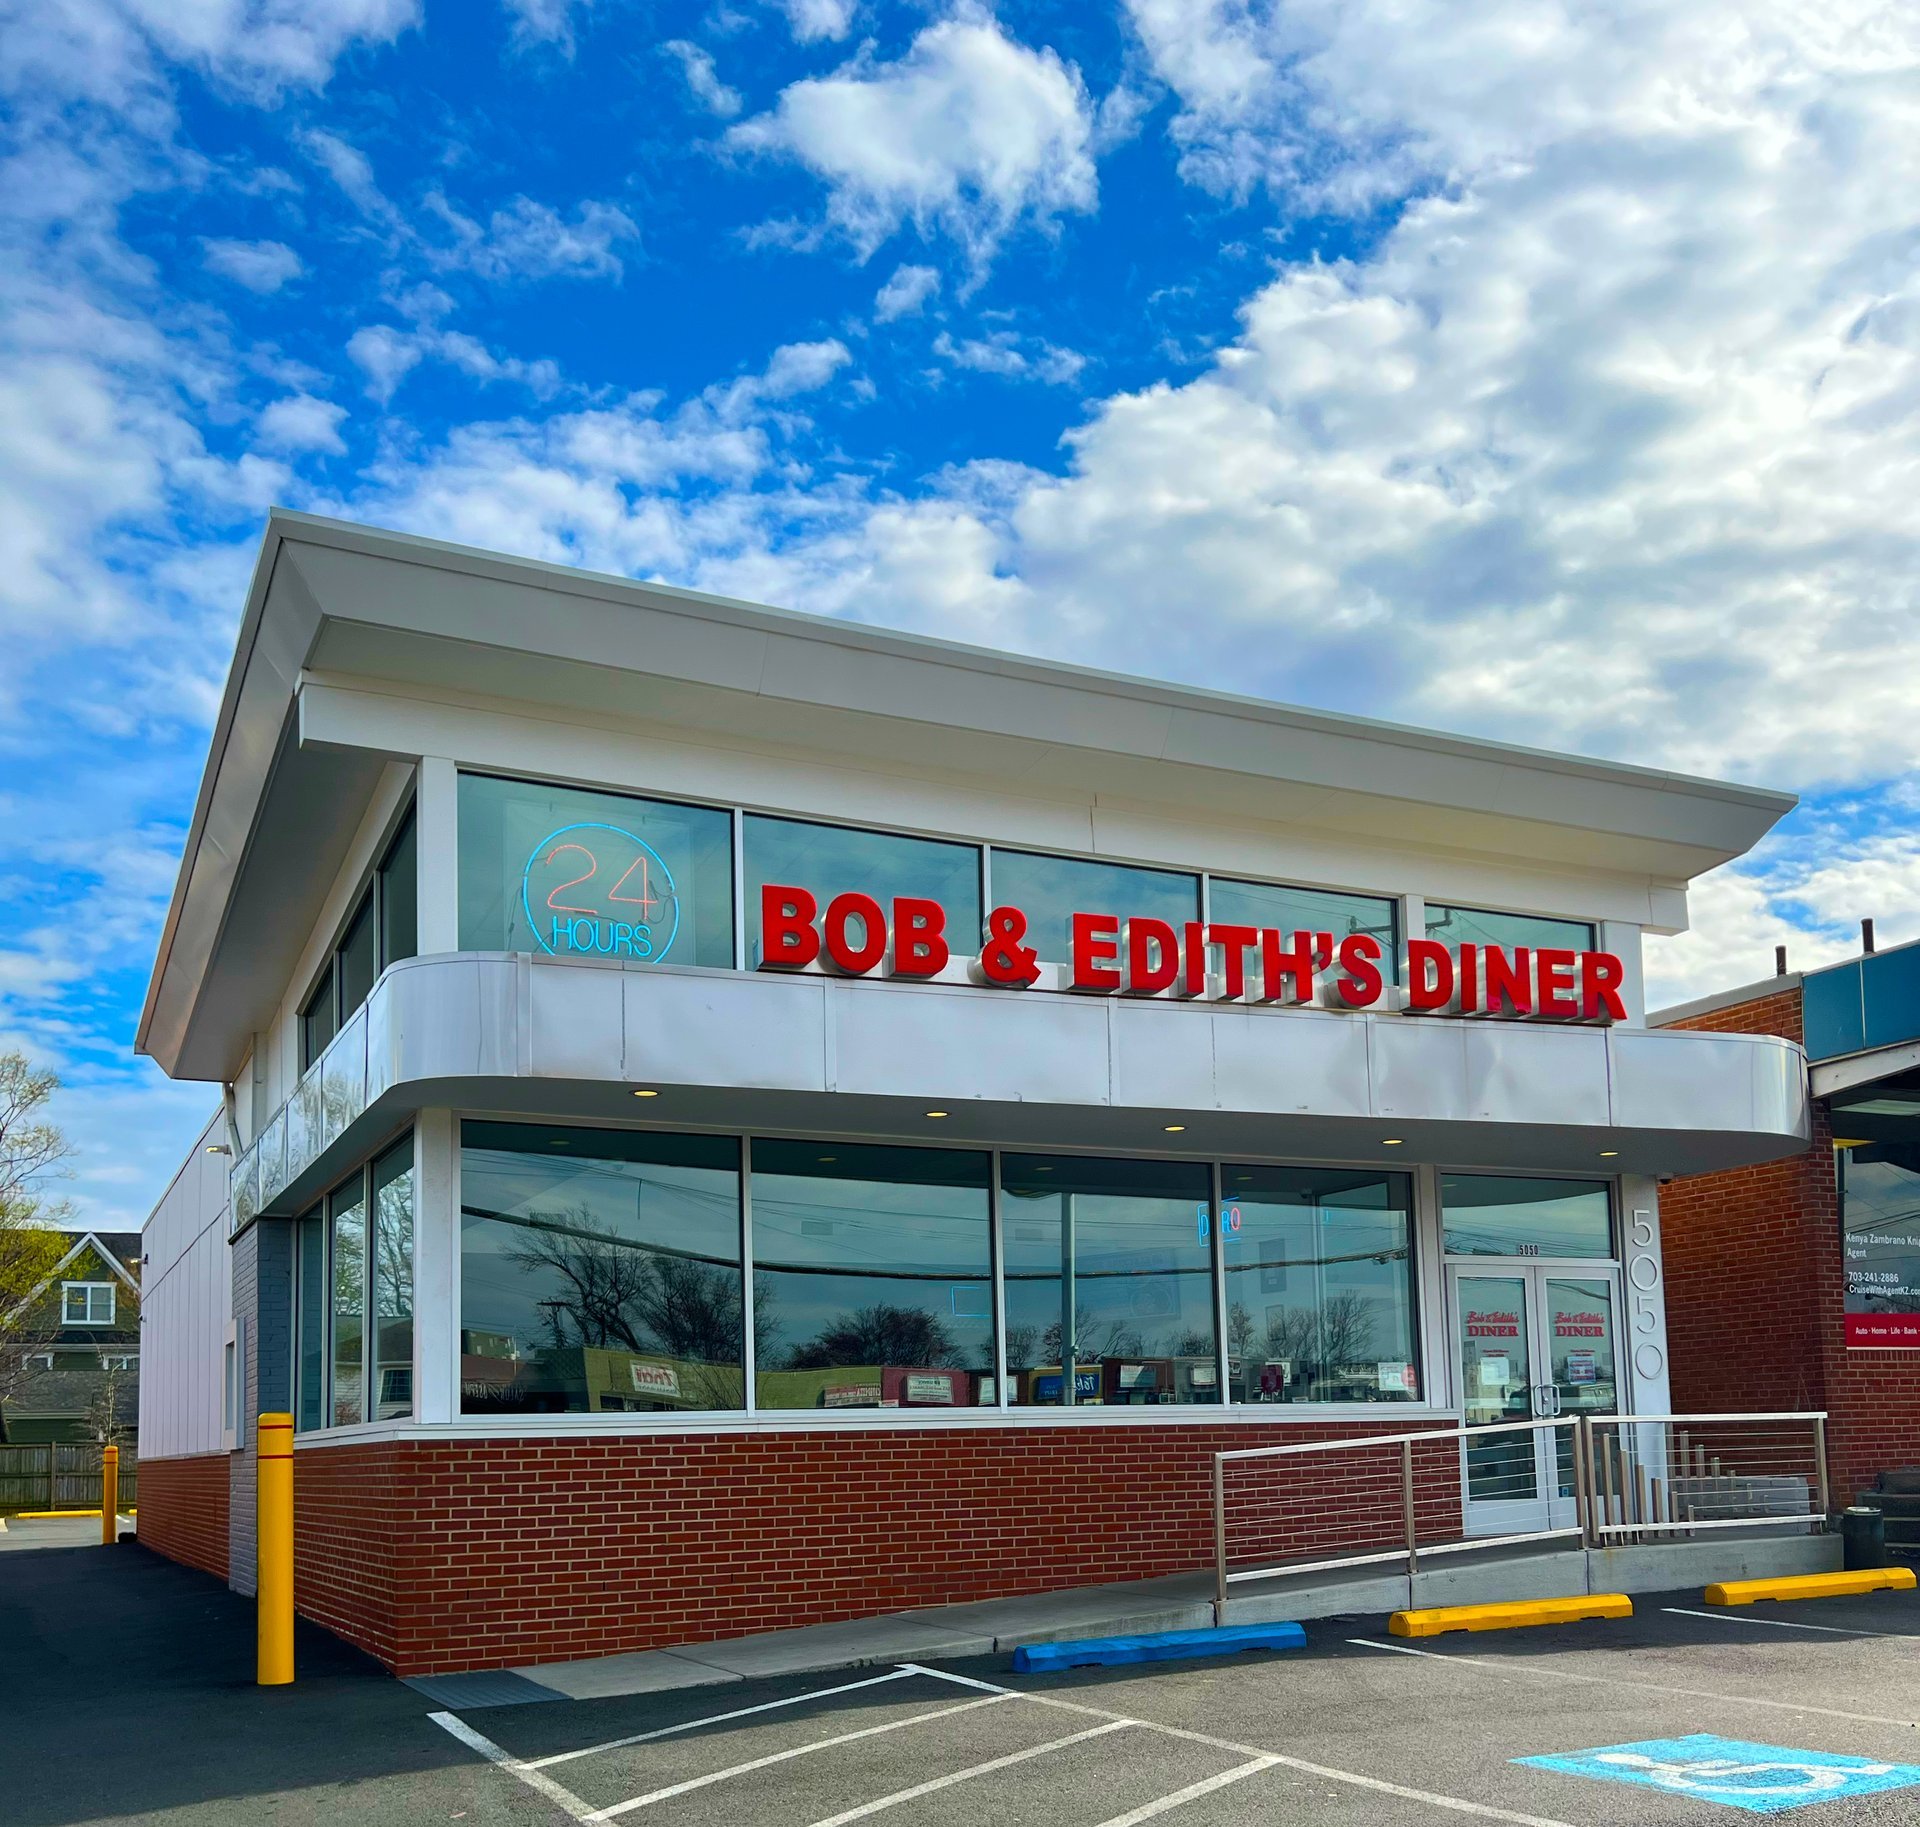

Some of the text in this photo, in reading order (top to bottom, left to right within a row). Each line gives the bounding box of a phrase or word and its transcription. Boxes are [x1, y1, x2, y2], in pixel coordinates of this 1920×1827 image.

[546, 844, 657, 920] 24
[551, 915, 653, 957] HOURS
[761, 883, 1628, 1021] BOB & EDITH'S DINER
[1845, 1232, 1868, 1245] Kenya
[1869, 1233, 1906, 1246] Zambrano
[1518, 1244, 1539, 1256] 5050
[1847, 1247, 1867, 1258] Agent
[1848, 1271, 1899, 1283] 703-241-2886
[1466, 1325, 1519, 1336] DINER
[1555, 1325, 1605, 1337] DINER
[1855, 1326, 1868, 1334] Auto
[1871, 1326, 1887, 1335] Home
[1903, 1326, 1917, 1335] Bank
